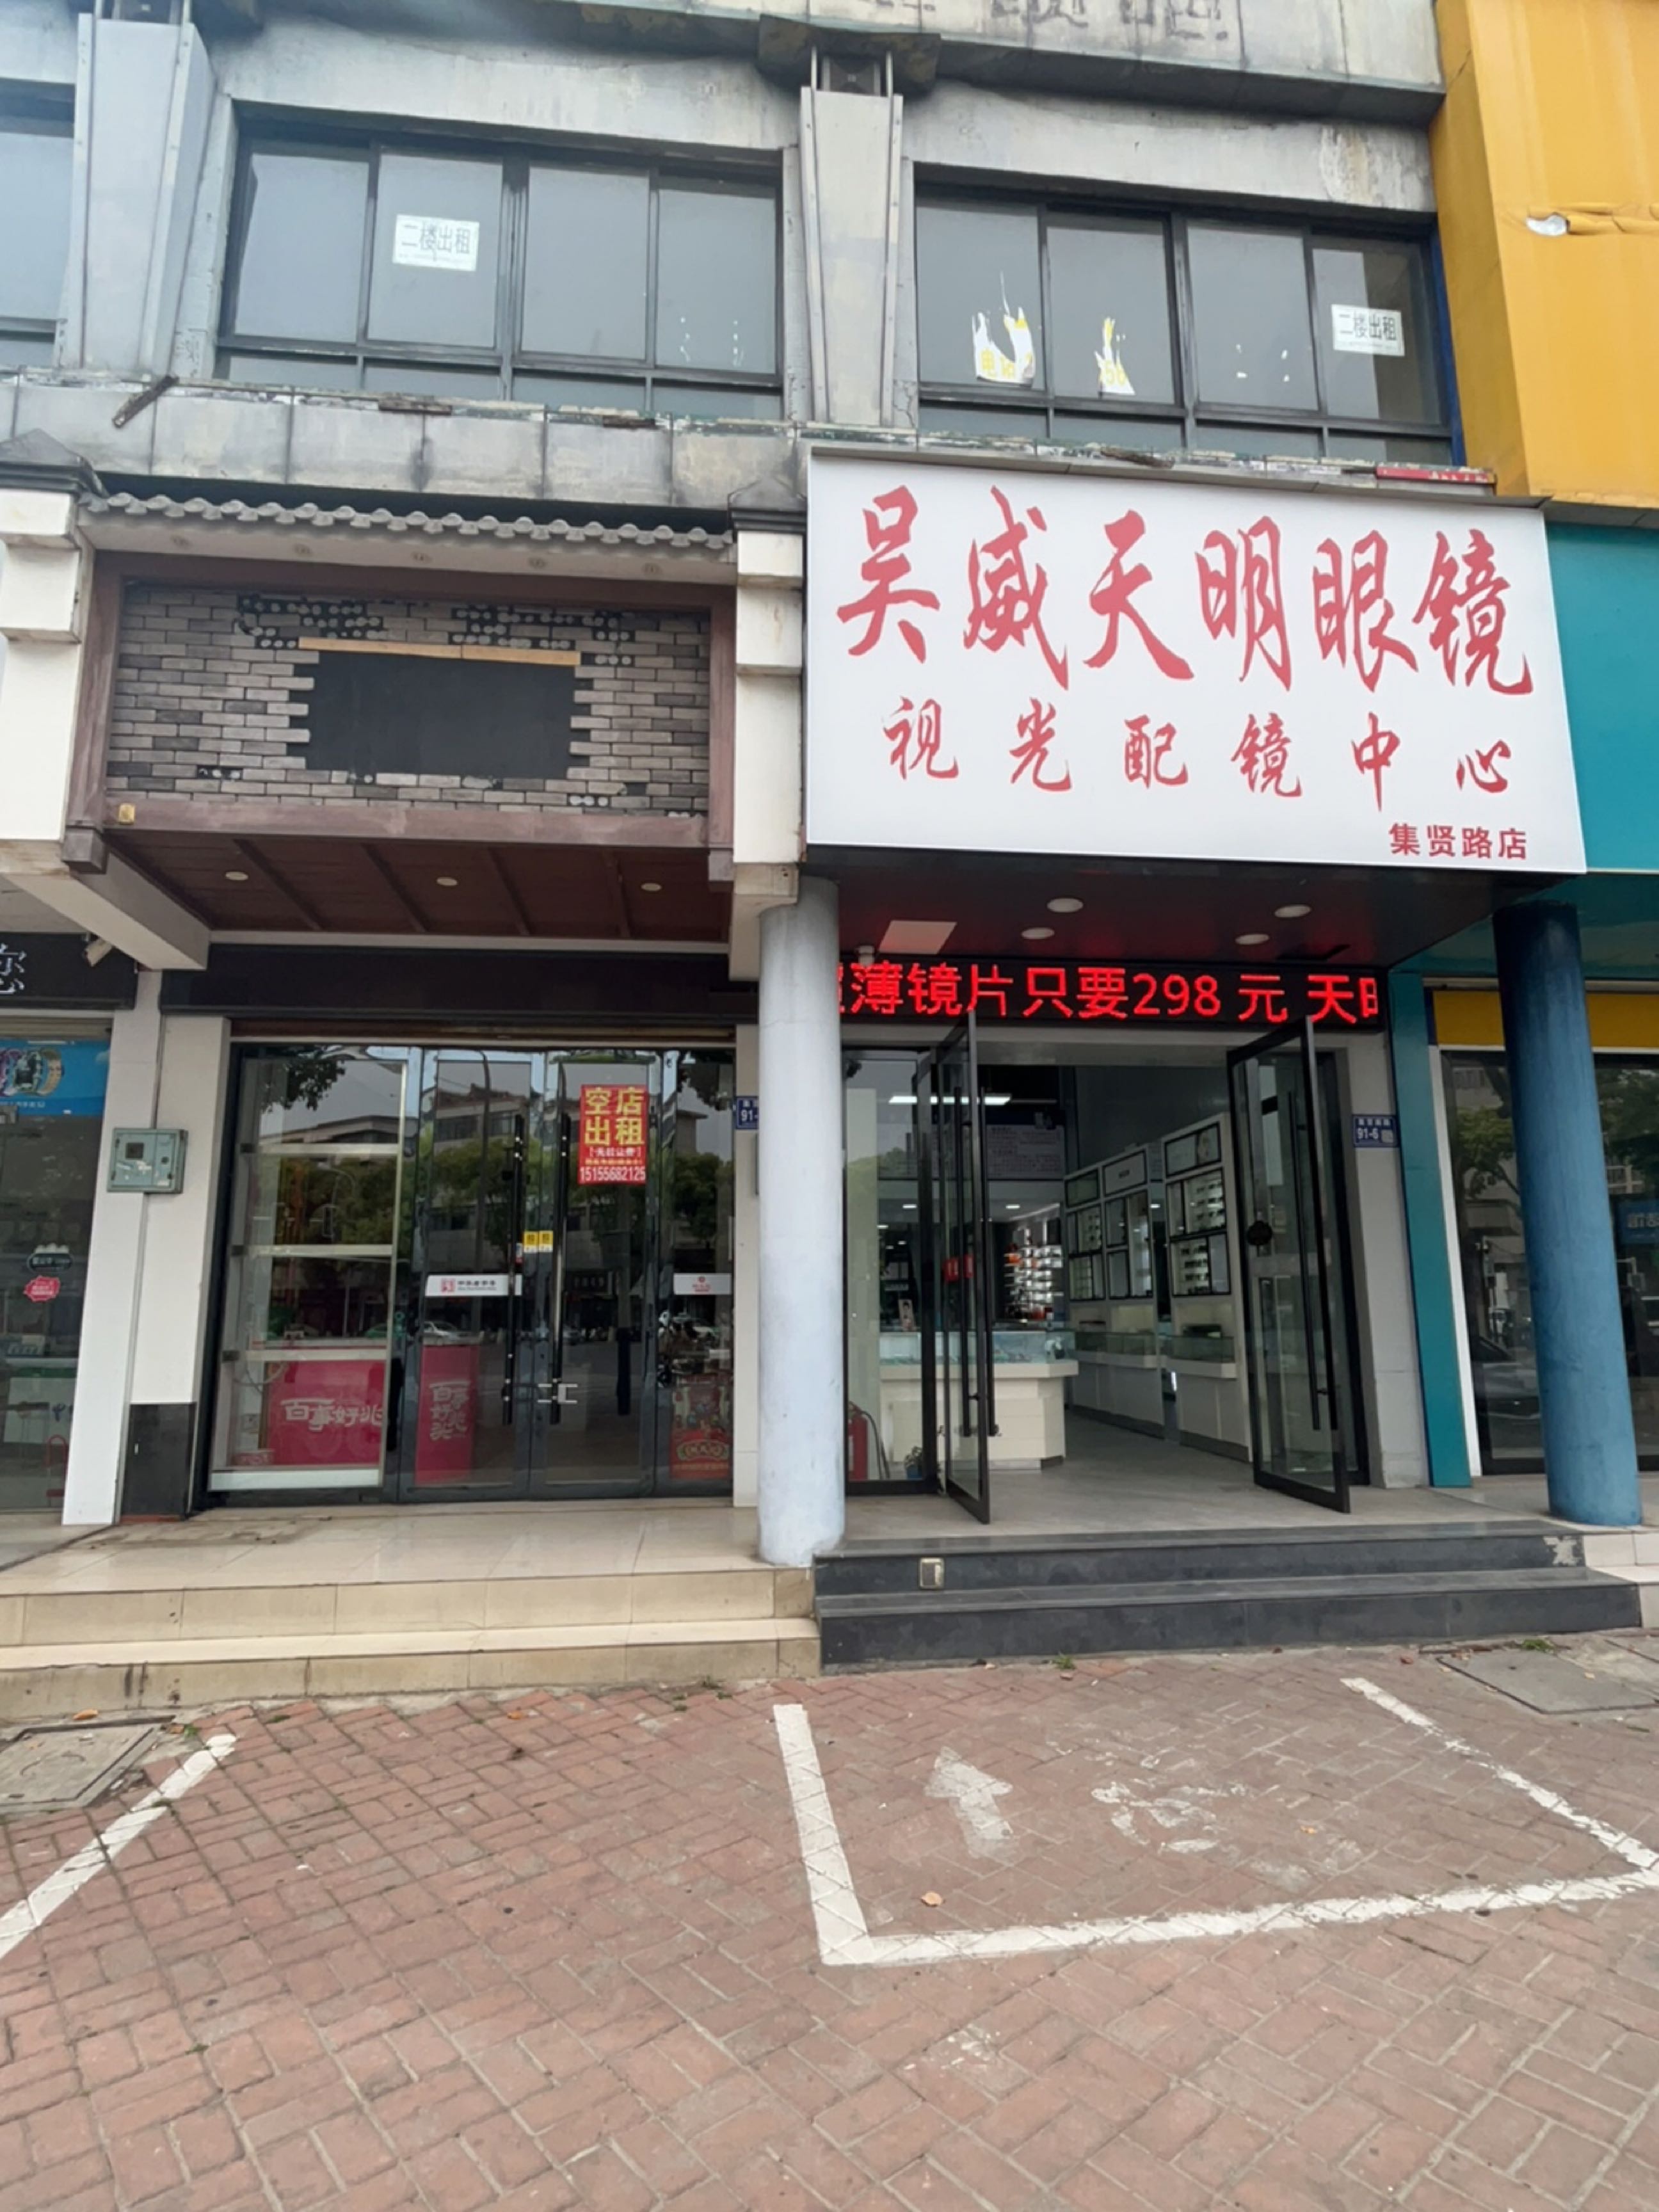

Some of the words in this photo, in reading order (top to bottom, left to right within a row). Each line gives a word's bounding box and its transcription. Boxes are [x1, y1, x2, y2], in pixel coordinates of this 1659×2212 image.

[401, 221, 471, 254] 二楼出租
[1338, 312, 1398, 341] 二楼出租
[837, 485, 1534, 695] 吴威天明眼镜
[883, 696, 1512, 812] 视光配镜中心
[1389, 823, 1527, 860] 集贤路店
[584, 1087, 645, 1115] 空店
[584, 1115, 645, 1146] 出租
